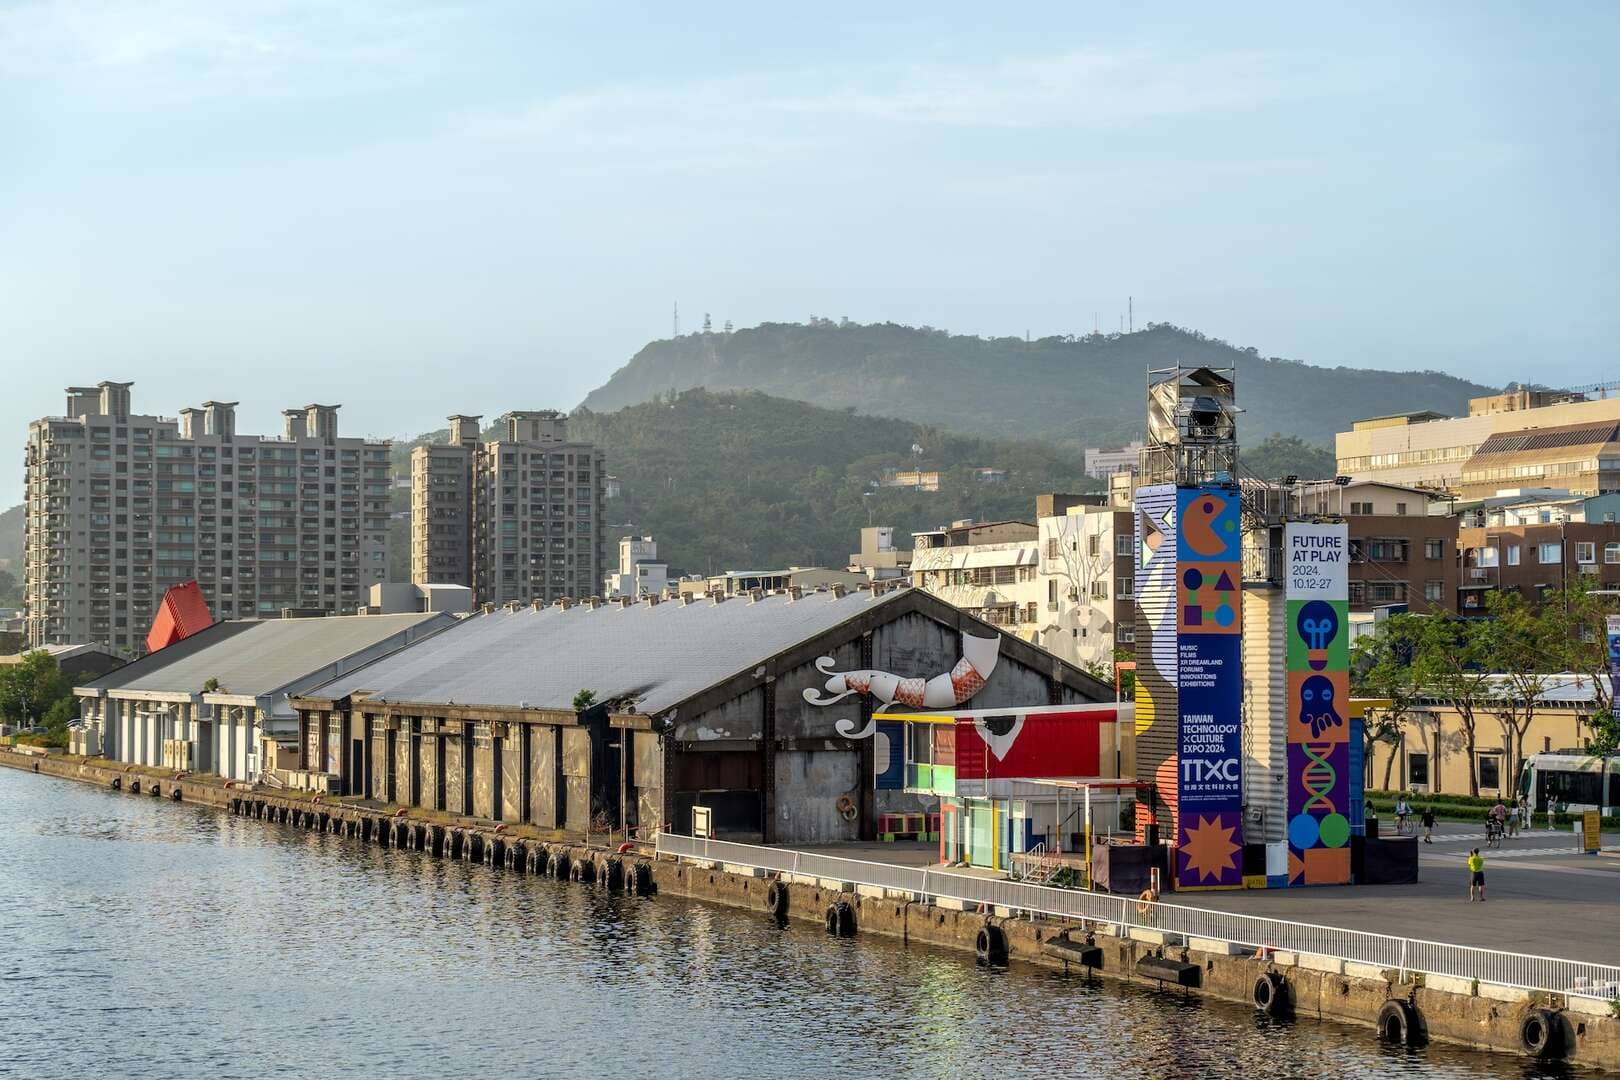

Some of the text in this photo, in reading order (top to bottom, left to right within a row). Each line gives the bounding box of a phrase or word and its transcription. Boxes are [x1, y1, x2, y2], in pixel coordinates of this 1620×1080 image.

[1293, 536, 1341, 548] FUTURE
[1293, 550, 1341, 562] AT PLAY
[1292, 565, 1320, 576] 2024.
[1294, 578, 1332, 588] 10.12-27
[1183, 714, 1214, 724] TAIWAN
[1183, 724, 1238, 734] TECHNOLOGY
[1184, 744, 1225, 753] EXPO 2024
[1181, 758, 1239, 782] TTXC
